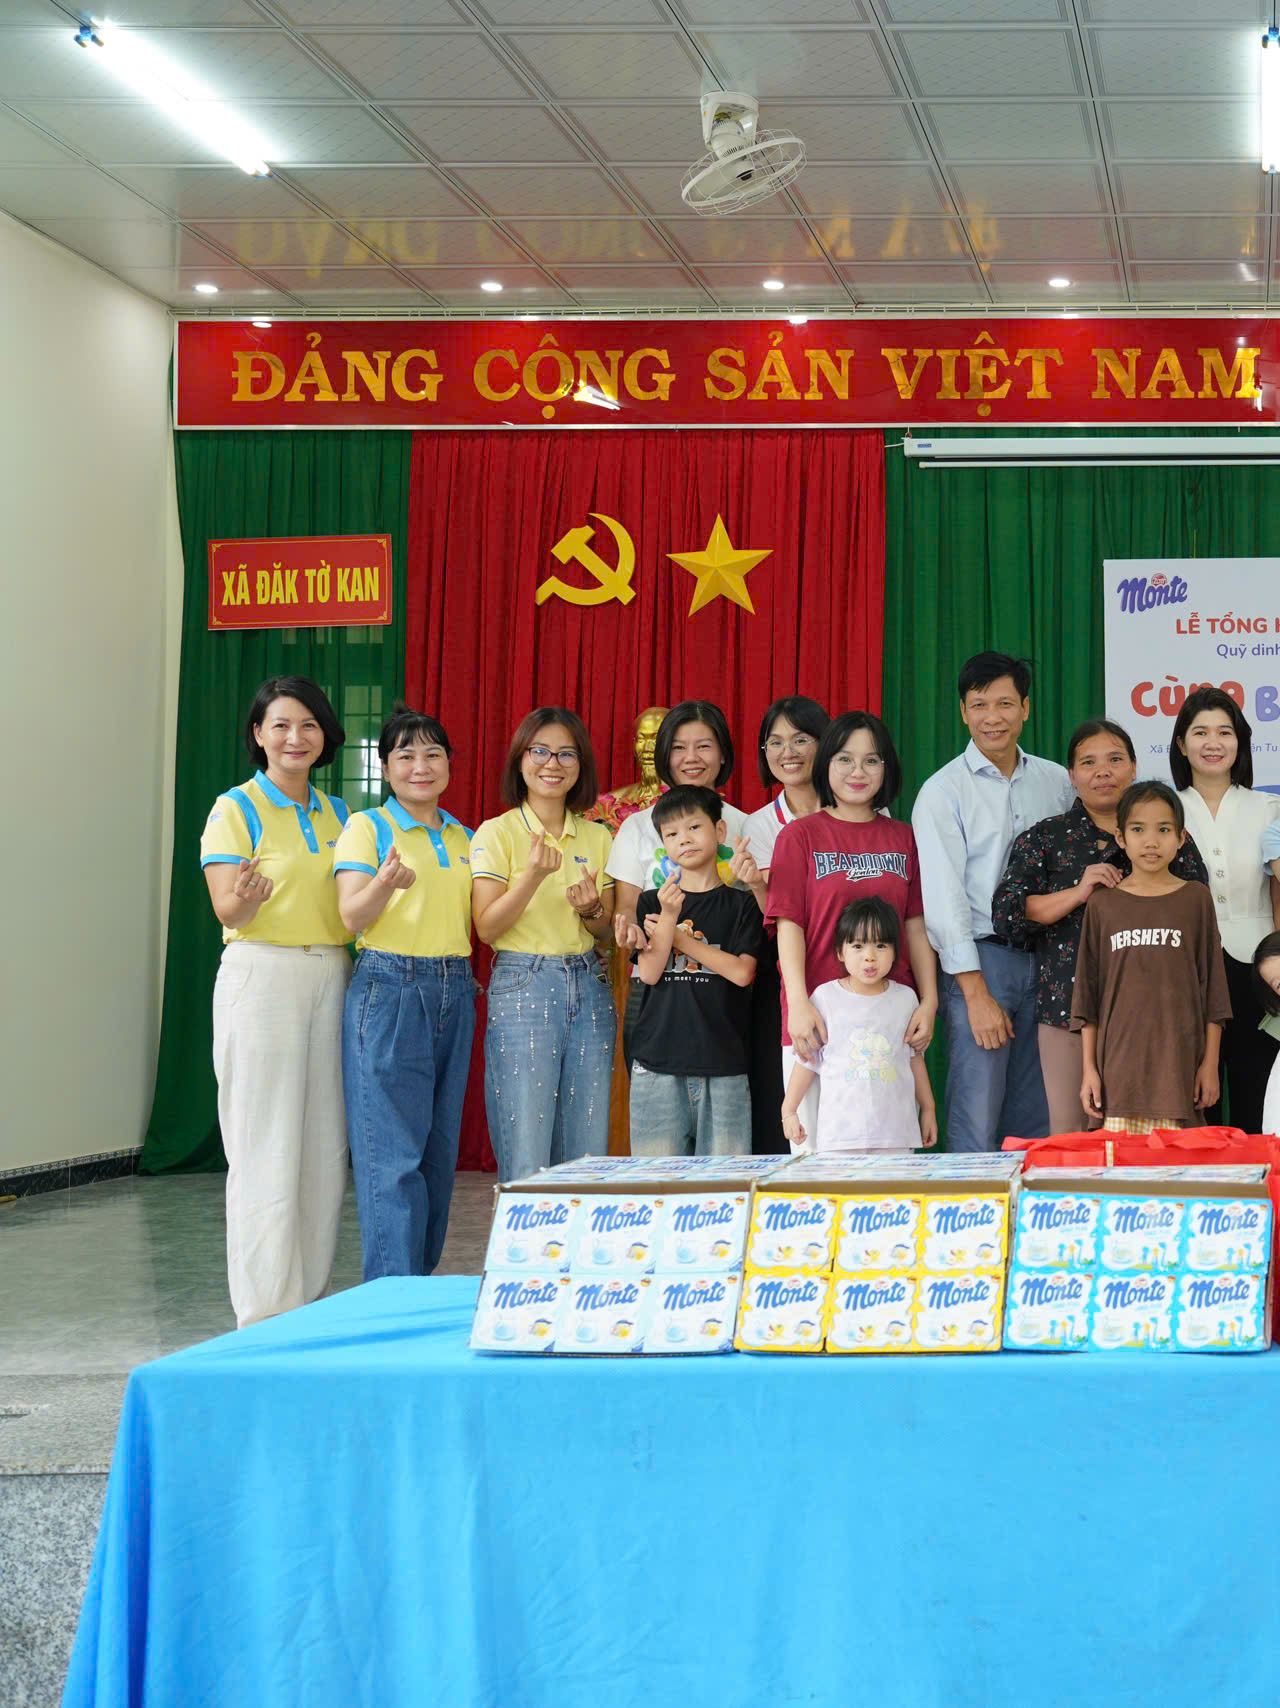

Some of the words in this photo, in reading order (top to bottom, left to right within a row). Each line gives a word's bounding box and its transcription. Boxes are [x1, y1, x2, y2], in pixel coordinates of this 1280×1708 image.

[232, 332, 443, 402] ĐẢNG
[473, 334, 676, 419] CỘNG
[704, 331, 854, 401] SẢN
[881, 331, 1064, 417] VIỆT
[1091, 347, 1261, 400] NAM
[222, 563, 251, 606] XÃ
[256, 562, 299, 605] ĐĂK
[304, 560, 331, 604] TỜ
[337, 567, 380, 603] KAN
[1117, 576, 1188, 614] Monte
[1176, 612, 1201, 635] LỄ
[1206, 612, 1268, 634] TỔNG
[1216, 643, 1247, 659] Quỹ
[813, 851, 909, 881] BEARDOWN
[1110, 928, 1182, 952] HERSHEY'S
[506, 1202, 569, 1231] Monte
[591, 1202, 653, 1232] Monte
[673, 1201, 734, 1232] Monte
[764, 1202, 826, 1231] Monte
[849, 1203, 911, 1234] Monte
[934, 1202, 996, 1234] Monte
[1029, 1202, 1091, 1231] Monte
[1113, 1204, 1175, 1233] Monte
[1197, 1207, 1259, 1236] Monte
[494, 1280, 558, 1309] Monte
[576, 1281, 640, 1311] Monte
[663, 1280, 726, 1310] Monte
[755, 1280, 818, 1309] Monte
[843, 1281, 906, 1311] Monte
[927, 1279, 990, 1310] Monte
[1021, 1277, 1083, 1306] Monte
[1104, 1277, 1166, 1309] Monte
[1187, 1276, 1250, 1308] Monte
